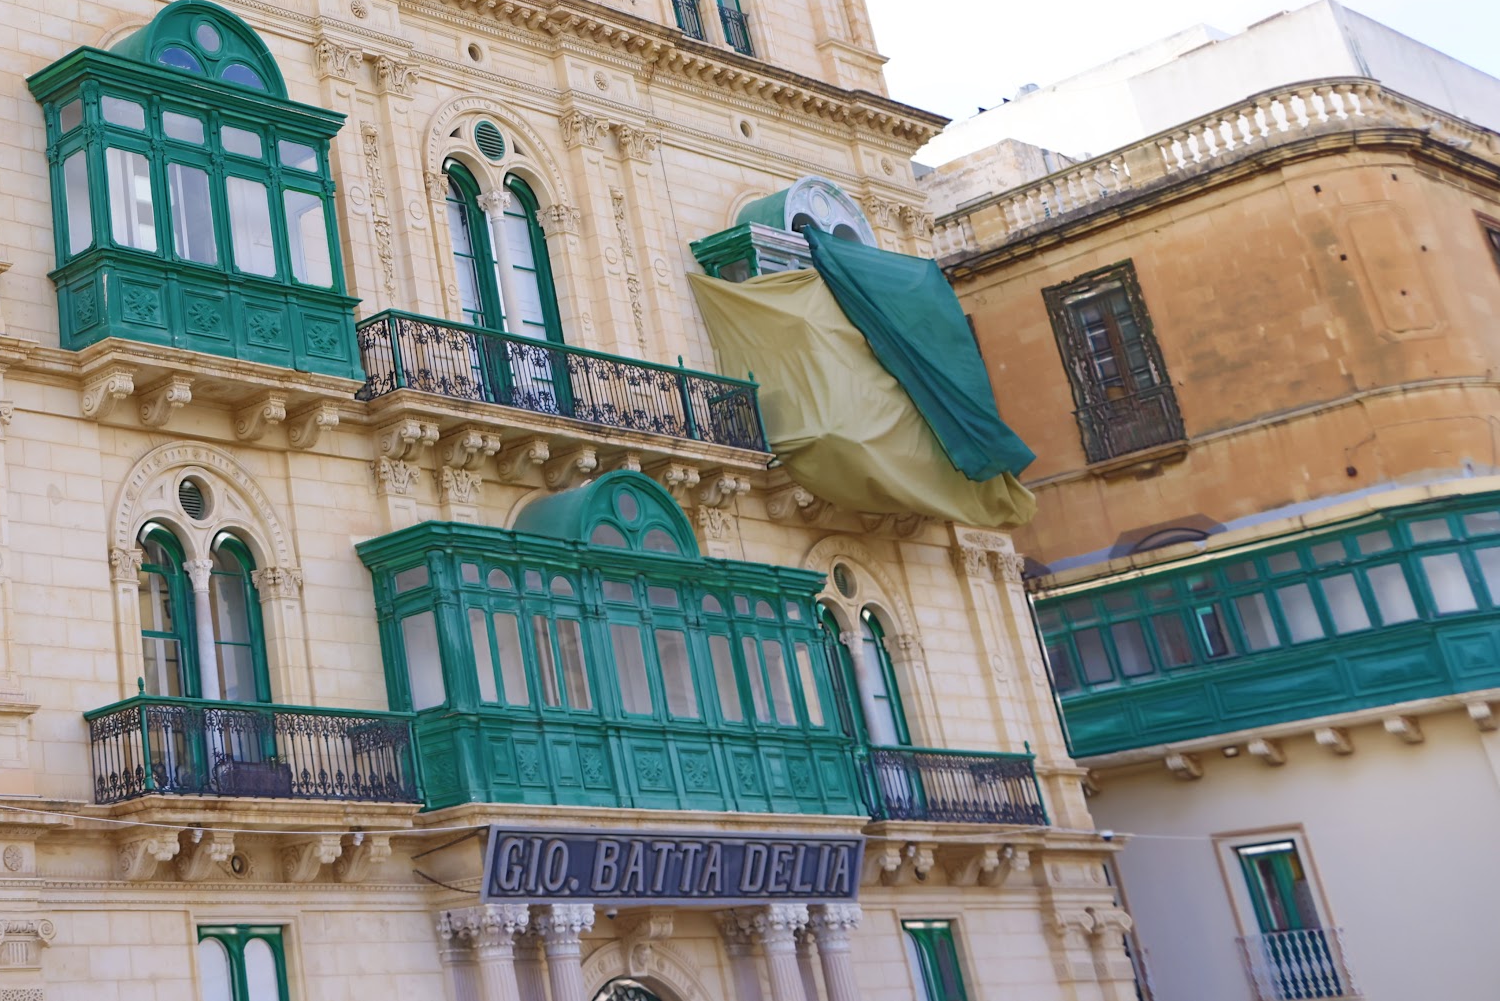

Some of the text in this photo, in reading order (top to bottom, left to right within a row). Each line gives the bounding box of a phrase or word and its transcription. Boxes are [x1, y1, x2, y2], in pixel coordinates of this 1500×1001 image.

[495, 836, 851, 894] GIO. BATTA DELIA
